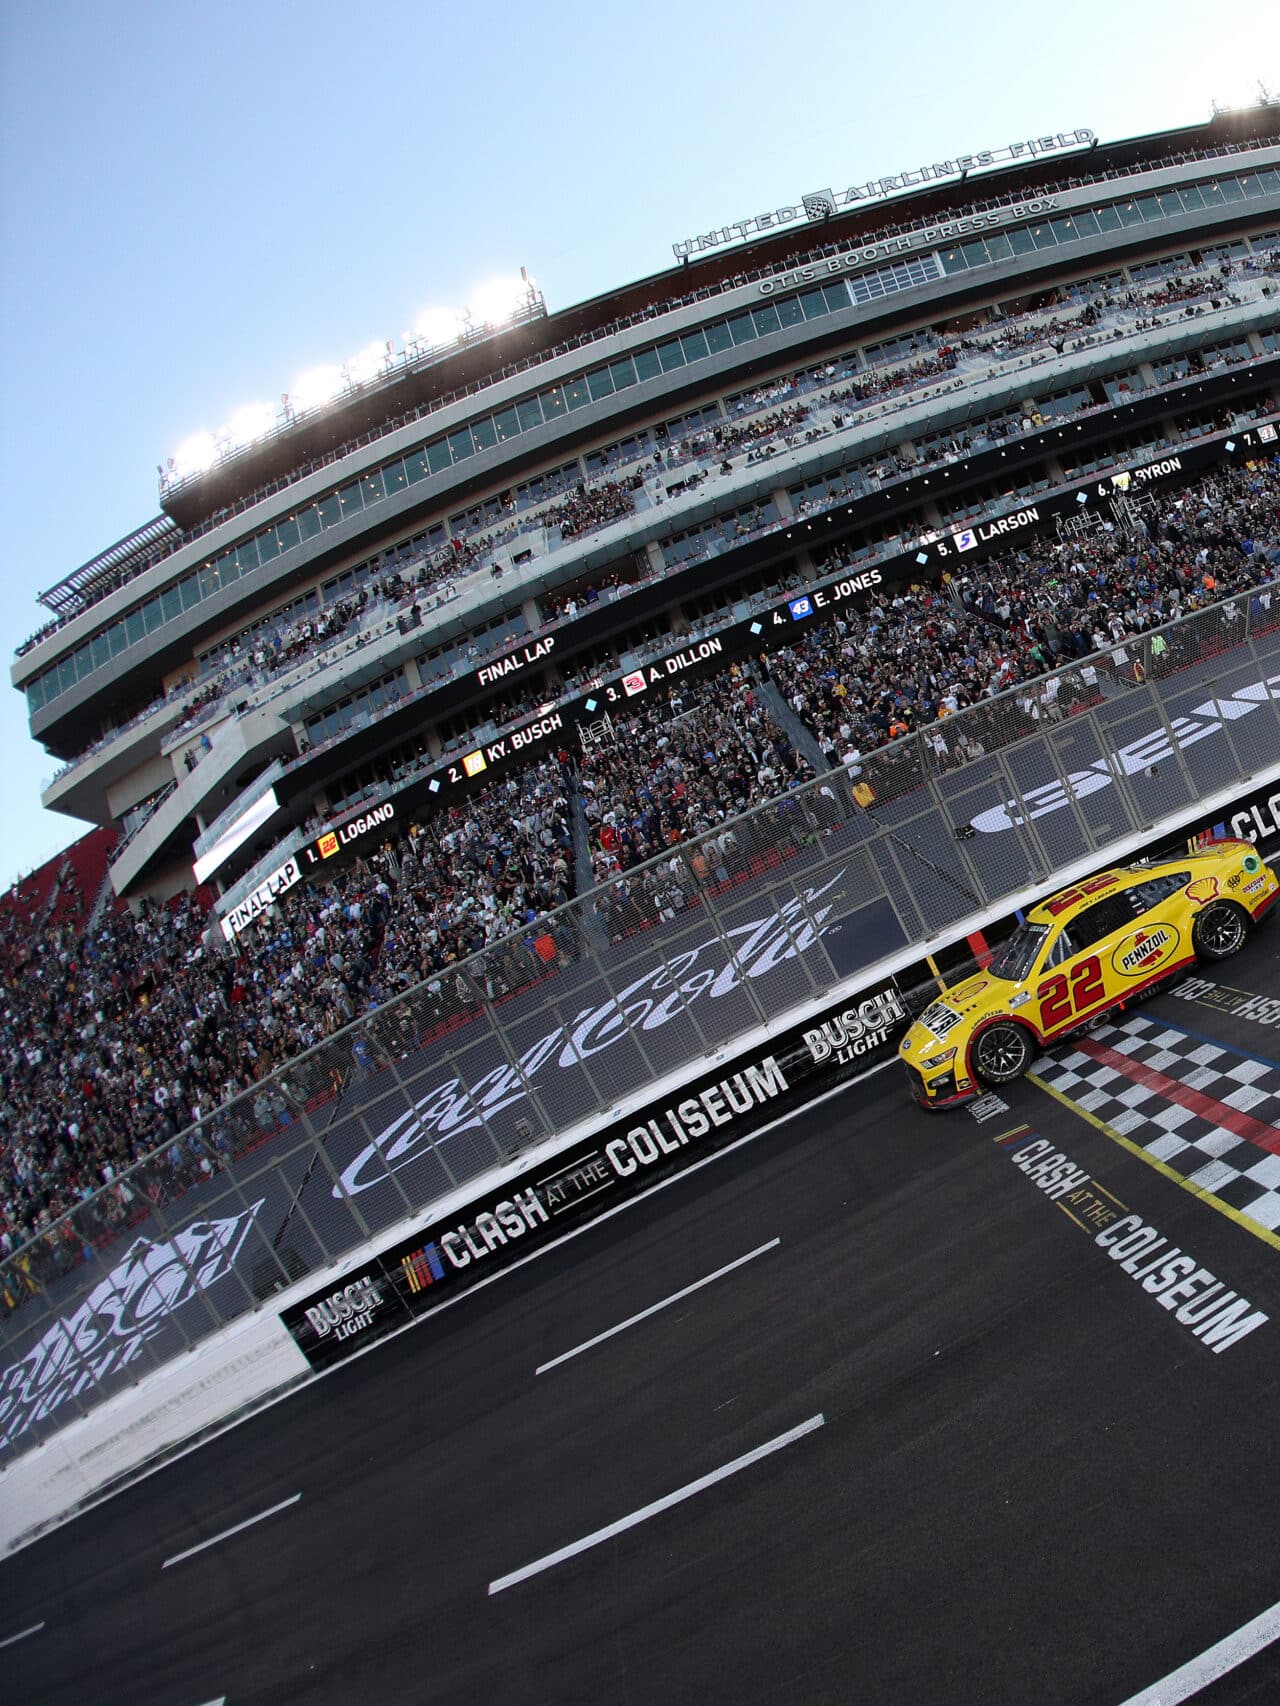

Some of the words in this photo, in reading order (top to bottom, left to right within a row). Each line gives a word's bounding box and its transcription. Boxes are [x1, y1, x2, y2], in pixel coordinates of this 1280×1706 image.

[672, 205, 798, 257] UNITED
[845, 151, 994, 204] AIRLINES
[1009, 128, 1094, 159] FIELD
[759, 269, 816, 295] OTIS
[828, 237, 912, 273] BOOTH
[924, 213, 999, 243] PRESS
[1013, 197, 1060, 219] BOX
[1135, 457, 1182, 482] BYRON
[978, 507, 1040, 542] LARSON
[814, 592, 831, 608] E.
[833, 569, 883, 601] JONES
[477, 655, 525, 686] FINAL
[526, 637, 556, 663] LAP
[649, 667, 665, 683] A.
[665, 637, 722, 675] DILLON
[511, 713, 563, 751] BUSCH
[338, 803, 395, 845] LOGANO
[229, 892, 268, 934] FINAL
[267, 863, 294, 899] LAP
[1121, 929, 1169, 971] PENNZOIL
[1037, 955, 1106, 1032] 22
[801, 987, 906, 1065] BUSCH
[837, 1026, 897, 1067] LIGHT
[440, 1187, 550, 1269] CLASH
[546, 1184, 571, 1208] AT
[573, 1163, 609, 1198] THE
[605, 1055, 790, 1178] COLISEUM
[1011, 1138, 1091, 1201] CLASH
[1066, 1188, 1094, 1205] AT
[1083, 1199, 1118, 1228] THE
[304, 1275, 385, 1339] BUSCH
[1094, 1214, 1270, 1354] COLISEUM
[334, 1310, 377, 1342] LIGHT
